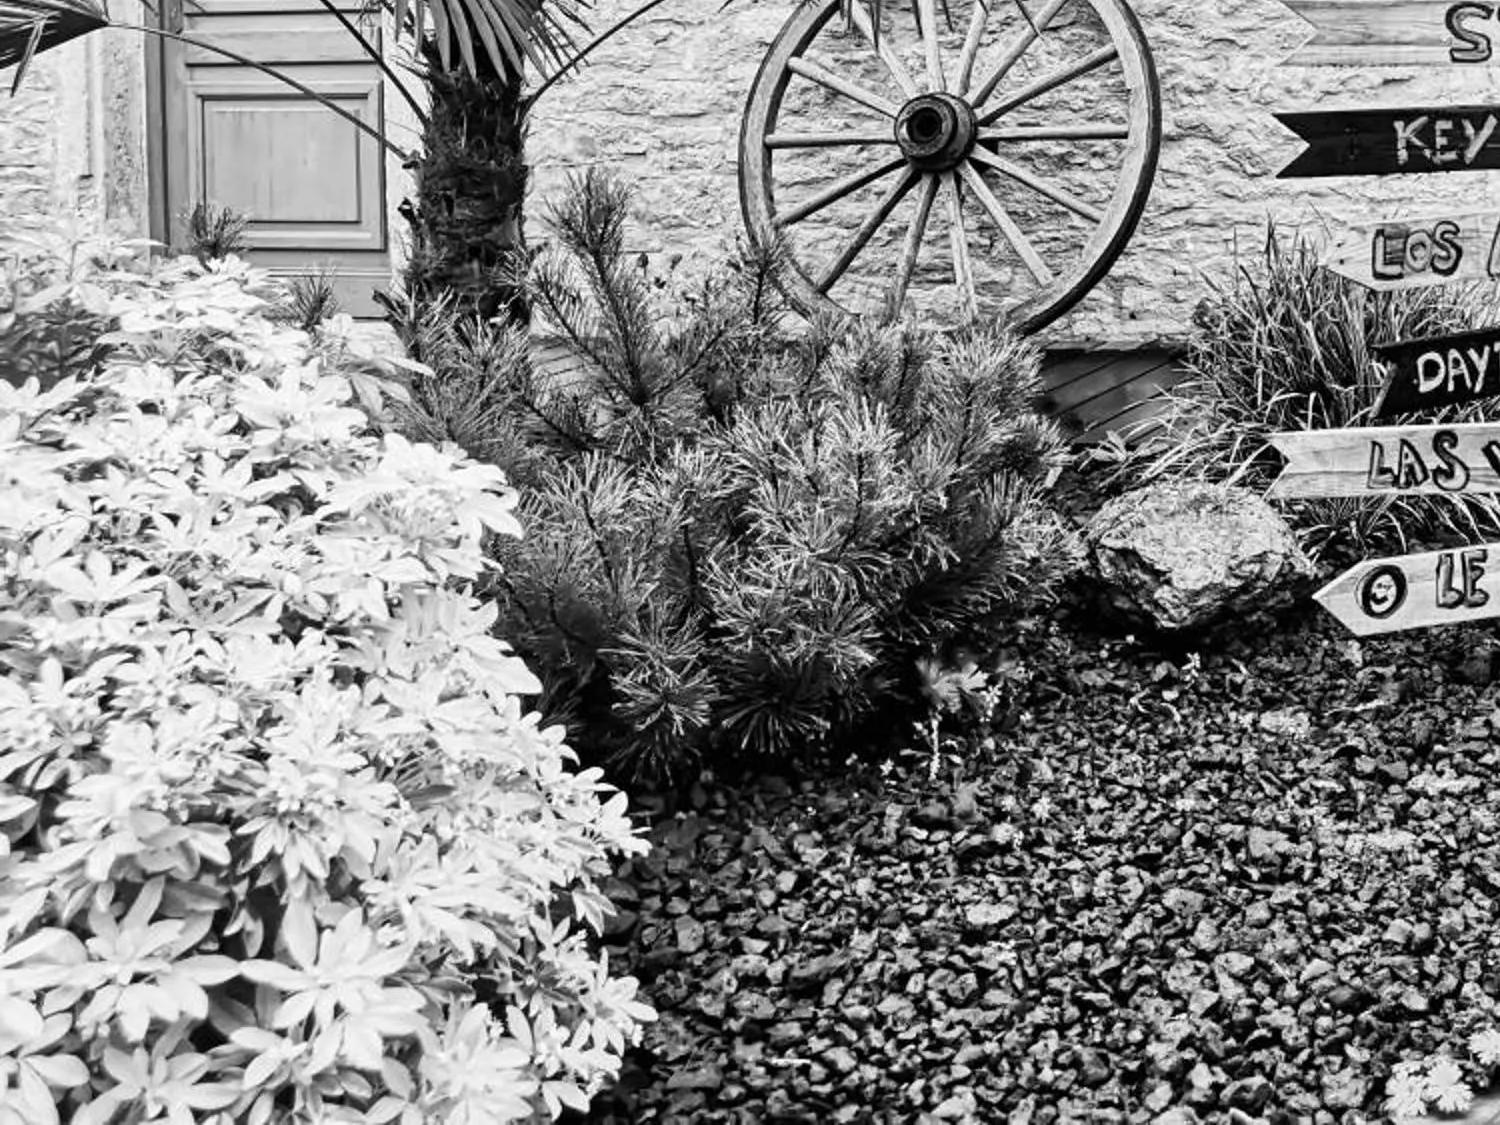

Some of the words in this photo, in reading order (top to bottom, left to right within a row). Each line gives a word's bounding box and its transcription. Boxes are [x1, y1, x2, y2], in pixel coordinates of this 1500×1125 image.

[1392, 114, 1499, 166] KEY
[1371, 220, 1463, 281] LOS
[1366, 428, 1473, 492] LAS
[1434, 549, 1490, 609] LE
